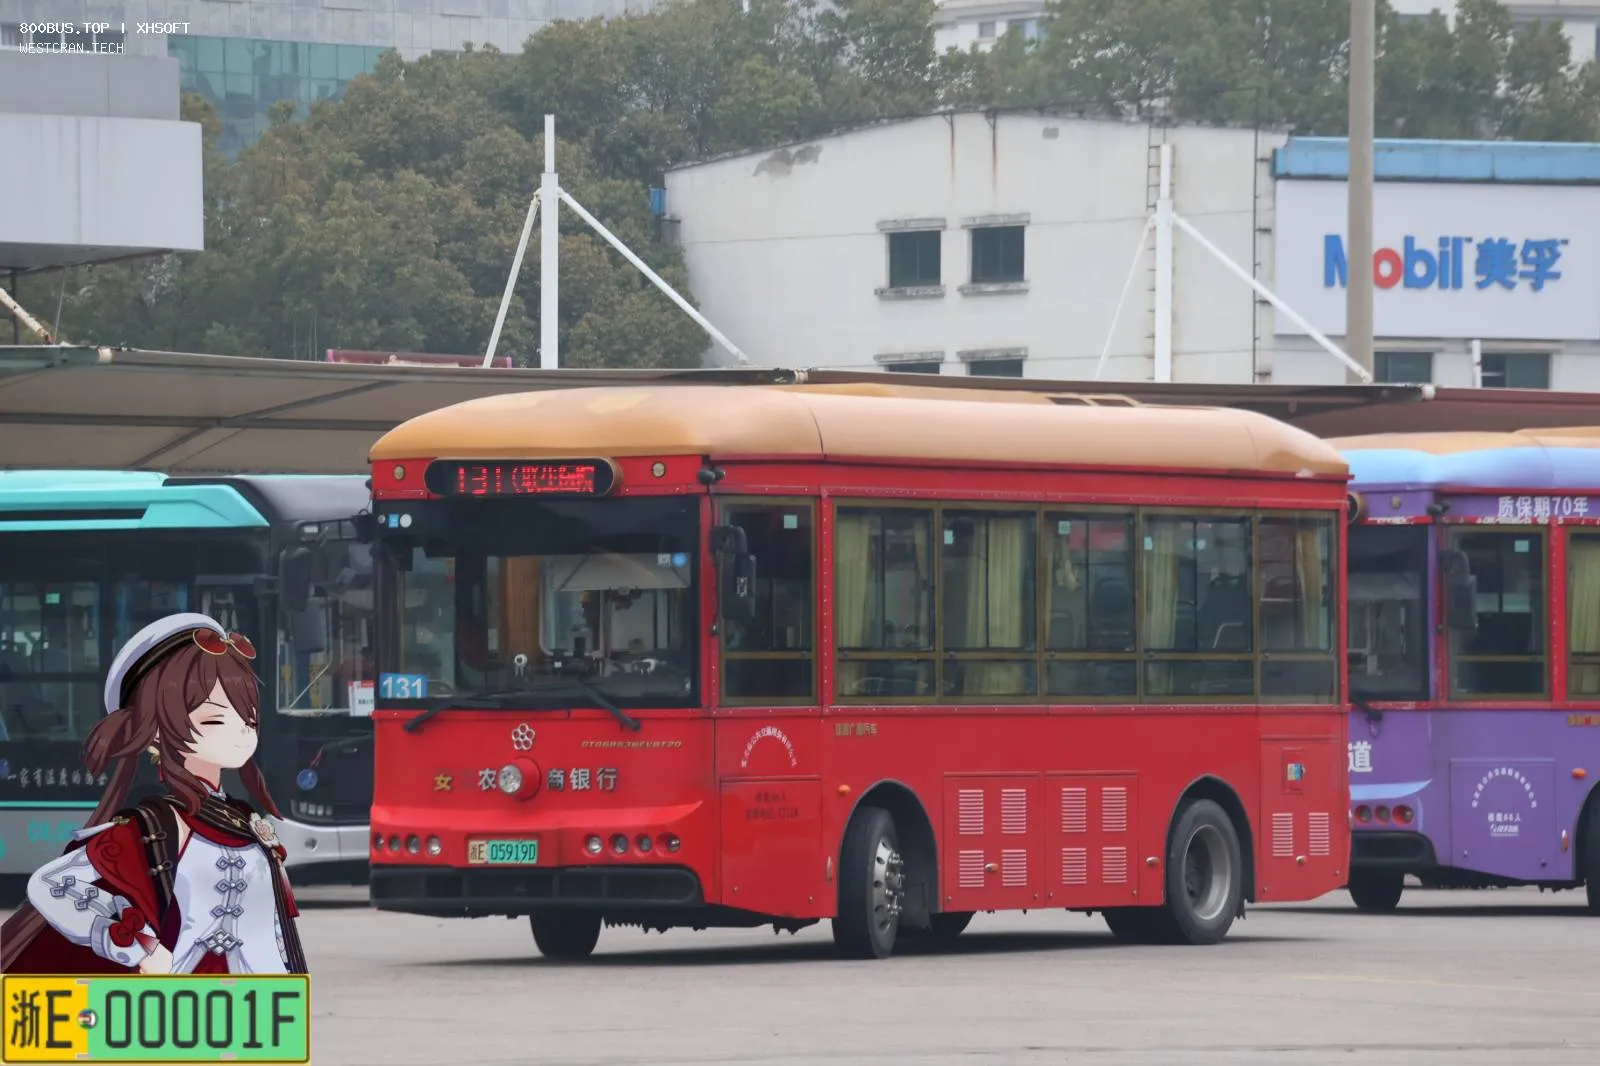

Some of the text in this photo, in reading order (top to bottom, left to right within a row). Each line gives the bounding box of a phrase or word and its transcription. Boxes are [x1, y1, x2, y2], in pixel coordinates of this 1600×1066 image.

[1475, 237, 1562, 291] 美孚
[457, 466, 502, 494] 131
[1498, 496, 1589, 517] 质保期70年
[382, 676, 423, 699] 131
[1348, 740, 1373, 773] 道
